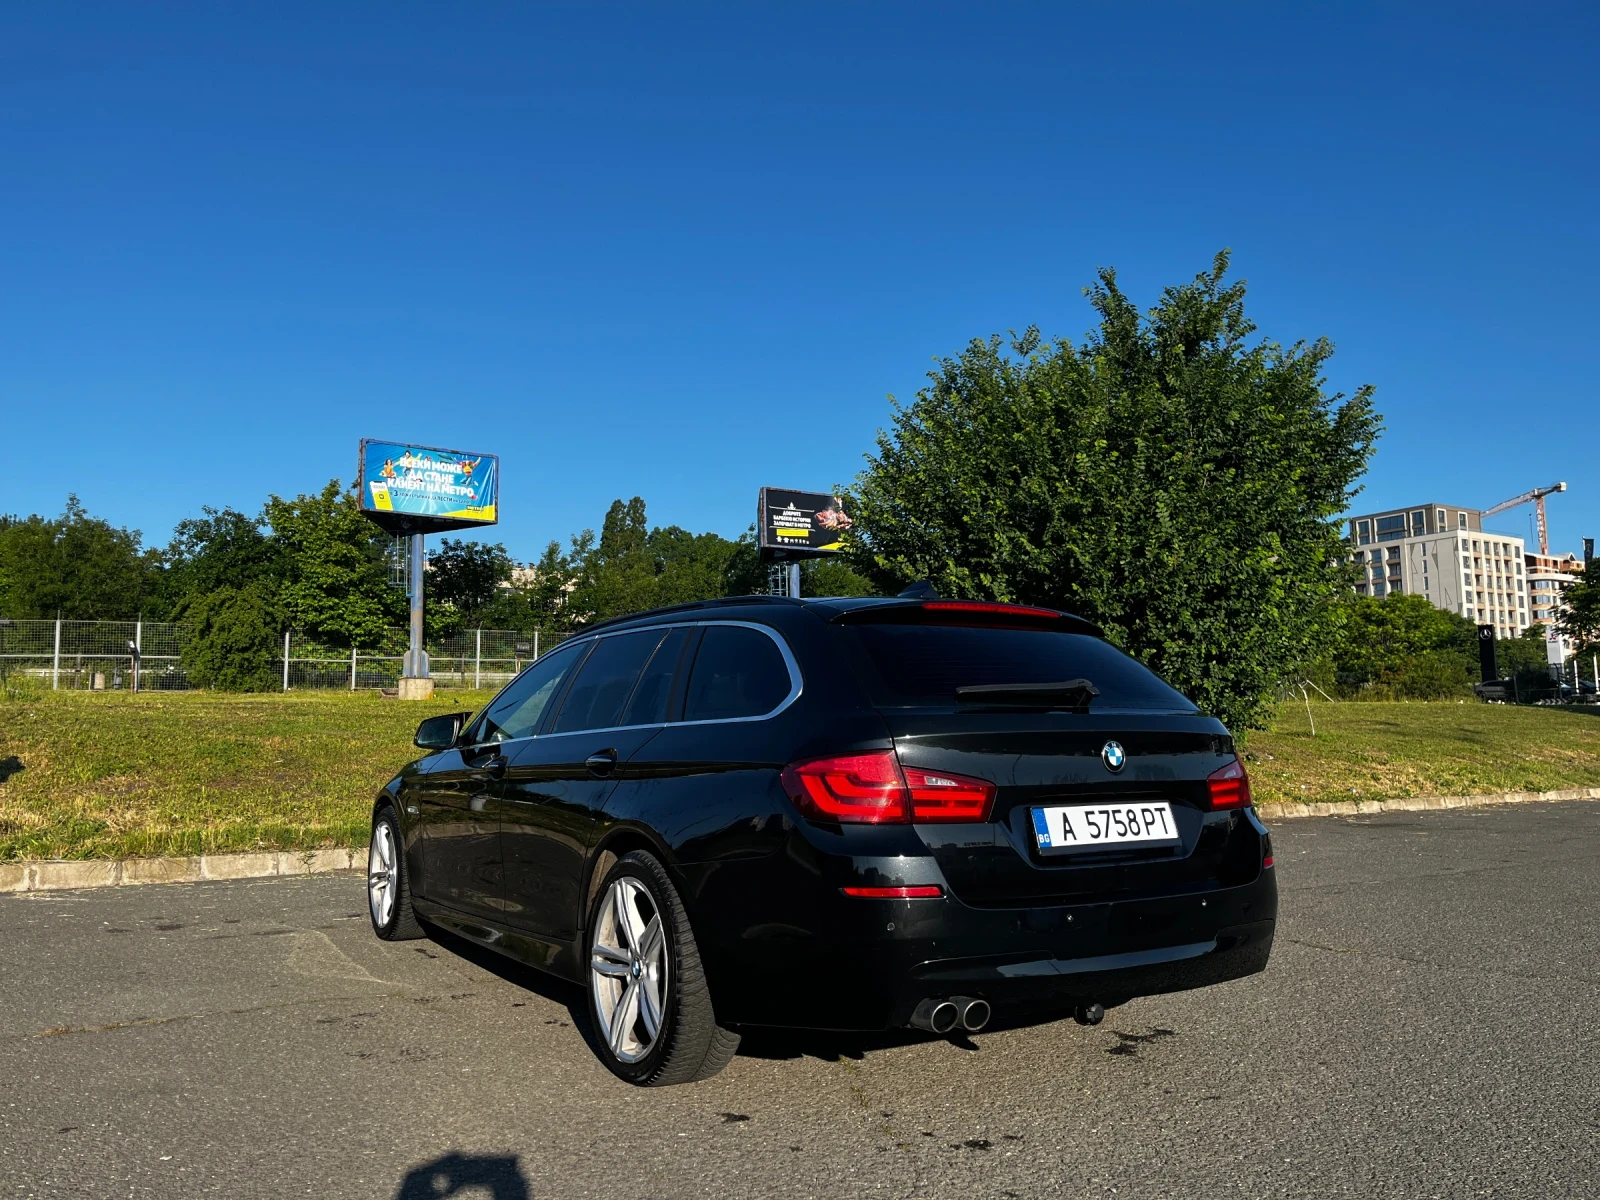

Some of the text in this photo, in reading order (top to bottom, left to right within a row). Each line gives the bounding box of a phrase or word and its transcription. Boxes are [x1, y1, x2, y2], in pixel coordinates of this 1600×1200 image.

[432, 461, 462, 474] МОЖЕ
[424, 471, 455, 484] СТАНЕ
[387, 478, 426, 491] КЛИЕНТ
[427, 482, 441, 494] НА
[441, 484, 475, 497] МЕТРО
[1062, 807, 1169, 841] A 5758 PT
[1038, 833, 1050, 843] BG
